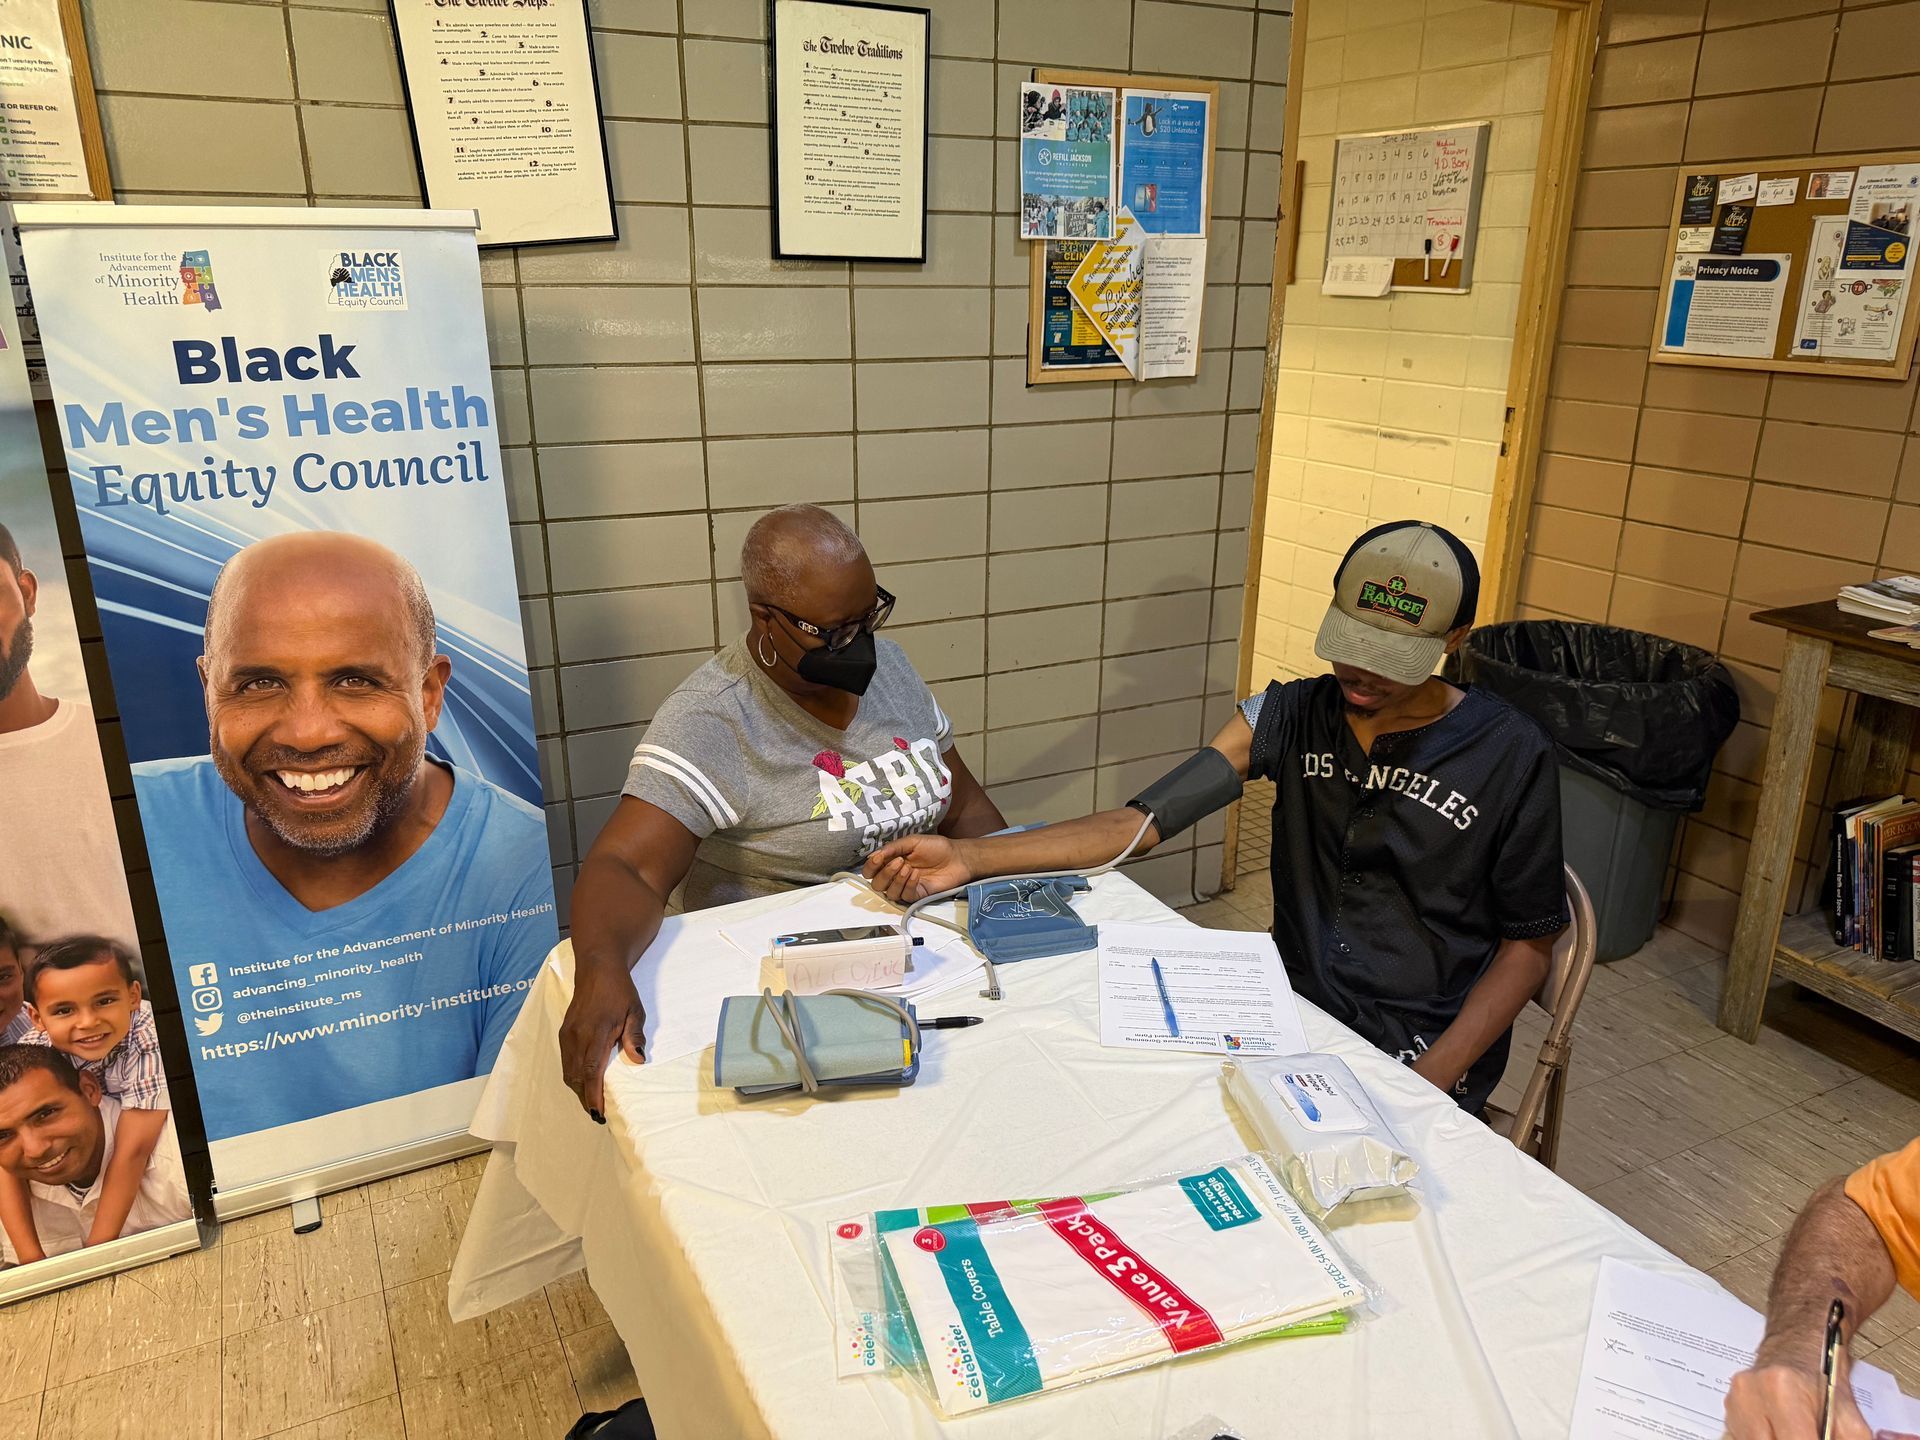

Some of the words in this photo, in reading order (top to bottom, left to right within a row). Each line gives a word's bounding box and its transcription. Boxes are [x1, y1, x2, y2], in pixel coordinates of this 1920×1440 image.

[803, 39, 817, 52] The
[820, 36, 854, 56] Twelve
[857, 39, 903, 60] Traditions
[1382, 135, 1398, 144] June
[1052, 152, 1069, 162] REFILL
[1070, 153, 1092, 163] JACKSON
[1382, 151, 1387, 161] 3
[1394, 149, 1401, 158] 4
[1407, 151, 1413, 160] 5
[1423, 149, 1429, 158] 6
[1340, 176, 1346, 186] 7
[1355, 173, 1360, 183] 8
[1367, 173, 1372, 183] 9
[1378, 173, 1385, 181] 10
[1393, 173, 1399, 181] 11
[1419, 170, 1428, 181] 13
[1337, 196, 1344, 208] 14
[1351, 196, 1359, 206] 15
[1363, 195, 1370, 203] 16
[1375, 194, 1384, 204] 17
[1389, 192, 1396, 201] 18
[1403, 193, 1411, 203] 19
[1417, 191, 1427, 201] 20
[1336, 217, 1344, 227] 21
[1348, 216, 1358, 227] 22
[1359, 216, 1369, 225] 23
[1371, 217, 1381, 227] 24
[1385, 215, 1395, 225] 25
[1399, 215, 1410, 224] 26
[1413, 215, 1423, 225] 27
[1335, 238, 1345, 247] 28
[1346, 235, 1355, 244] 29
[1359, 235, 1368, 246] 30
[1437, 234, 1444, 246] 8
[99, 252, 142, 262] Institute
[144, 252, 159, 262] for
[160, 251, 177, 262] the
[340, 252, 399, 268] BLACK
[109, 262, 173, 273] Advancement
[1093, 269, 1117, 296] COMMUNITY
[1112, 246, 1133, 270] OUTREACH
[1698, 266, 1729, 276] Privacy
[1730, 266, 1760, 275] Notice
[95, 275, 106, 284] of
[108, 273, 179, 292] Minority
[336, 282, 403, 298] HEALTH
[123, 291, 179, 306] Health
[1127, 283, 1143, 301] JUNE
[338, 296, 367, 308] Equity
[369, 295, 404, 307] Council
[172, 334, 361, 385] Black
[63, 398, 269, 448] Men's
[283, 385, 489, 437] Health
[89, 456, 276, 515] Equity
[293, 441, 489, 493] Council
[1389, 580, 1405, 591] R
[1361, 589, 1425, 617] RANGE
[1301, 752, 1334, 778] OS
[818, 737, 952, 832] AERO
[229, 958, 292, 978] Institute
[293, 950, 313, 966] for
[316, 945, 340, 960] the
[342, 926, 437, 955] Advancement
[438, 923, 453, 935] of
[454, 911, 508, 934] Minority
[511, 901, 553, 920] Health
[232, 951, 423, 1000] advancing_minority_health
[237, 988, 363, 1025] @theinstitute_ms
[1314, 1073, 1338, 1096] Alcohol
[1208, 1176, 1245, 1219] rectangle
[1220, 1212, 1233, 1222] 54
[1290, 1215, 1301, 1225] IN
[1066, 1215, 1118, 1260] Pack
[1295, 1226, 1310, 1240] 108
[1308, 1245, 1322, 1256] IN
[1315, 1253, 1330, 1264] 54
[1106, 1256, 1138, 1278] 3
[961, 1258, 987, 1300] Covers
[1131, 1272, 1190, 1329] Value
[1343, 1289, 1355, 1298] 3
[981, 1302, 1004, 1338] Table
[949, 1323, 982, 1398] celebrate!
